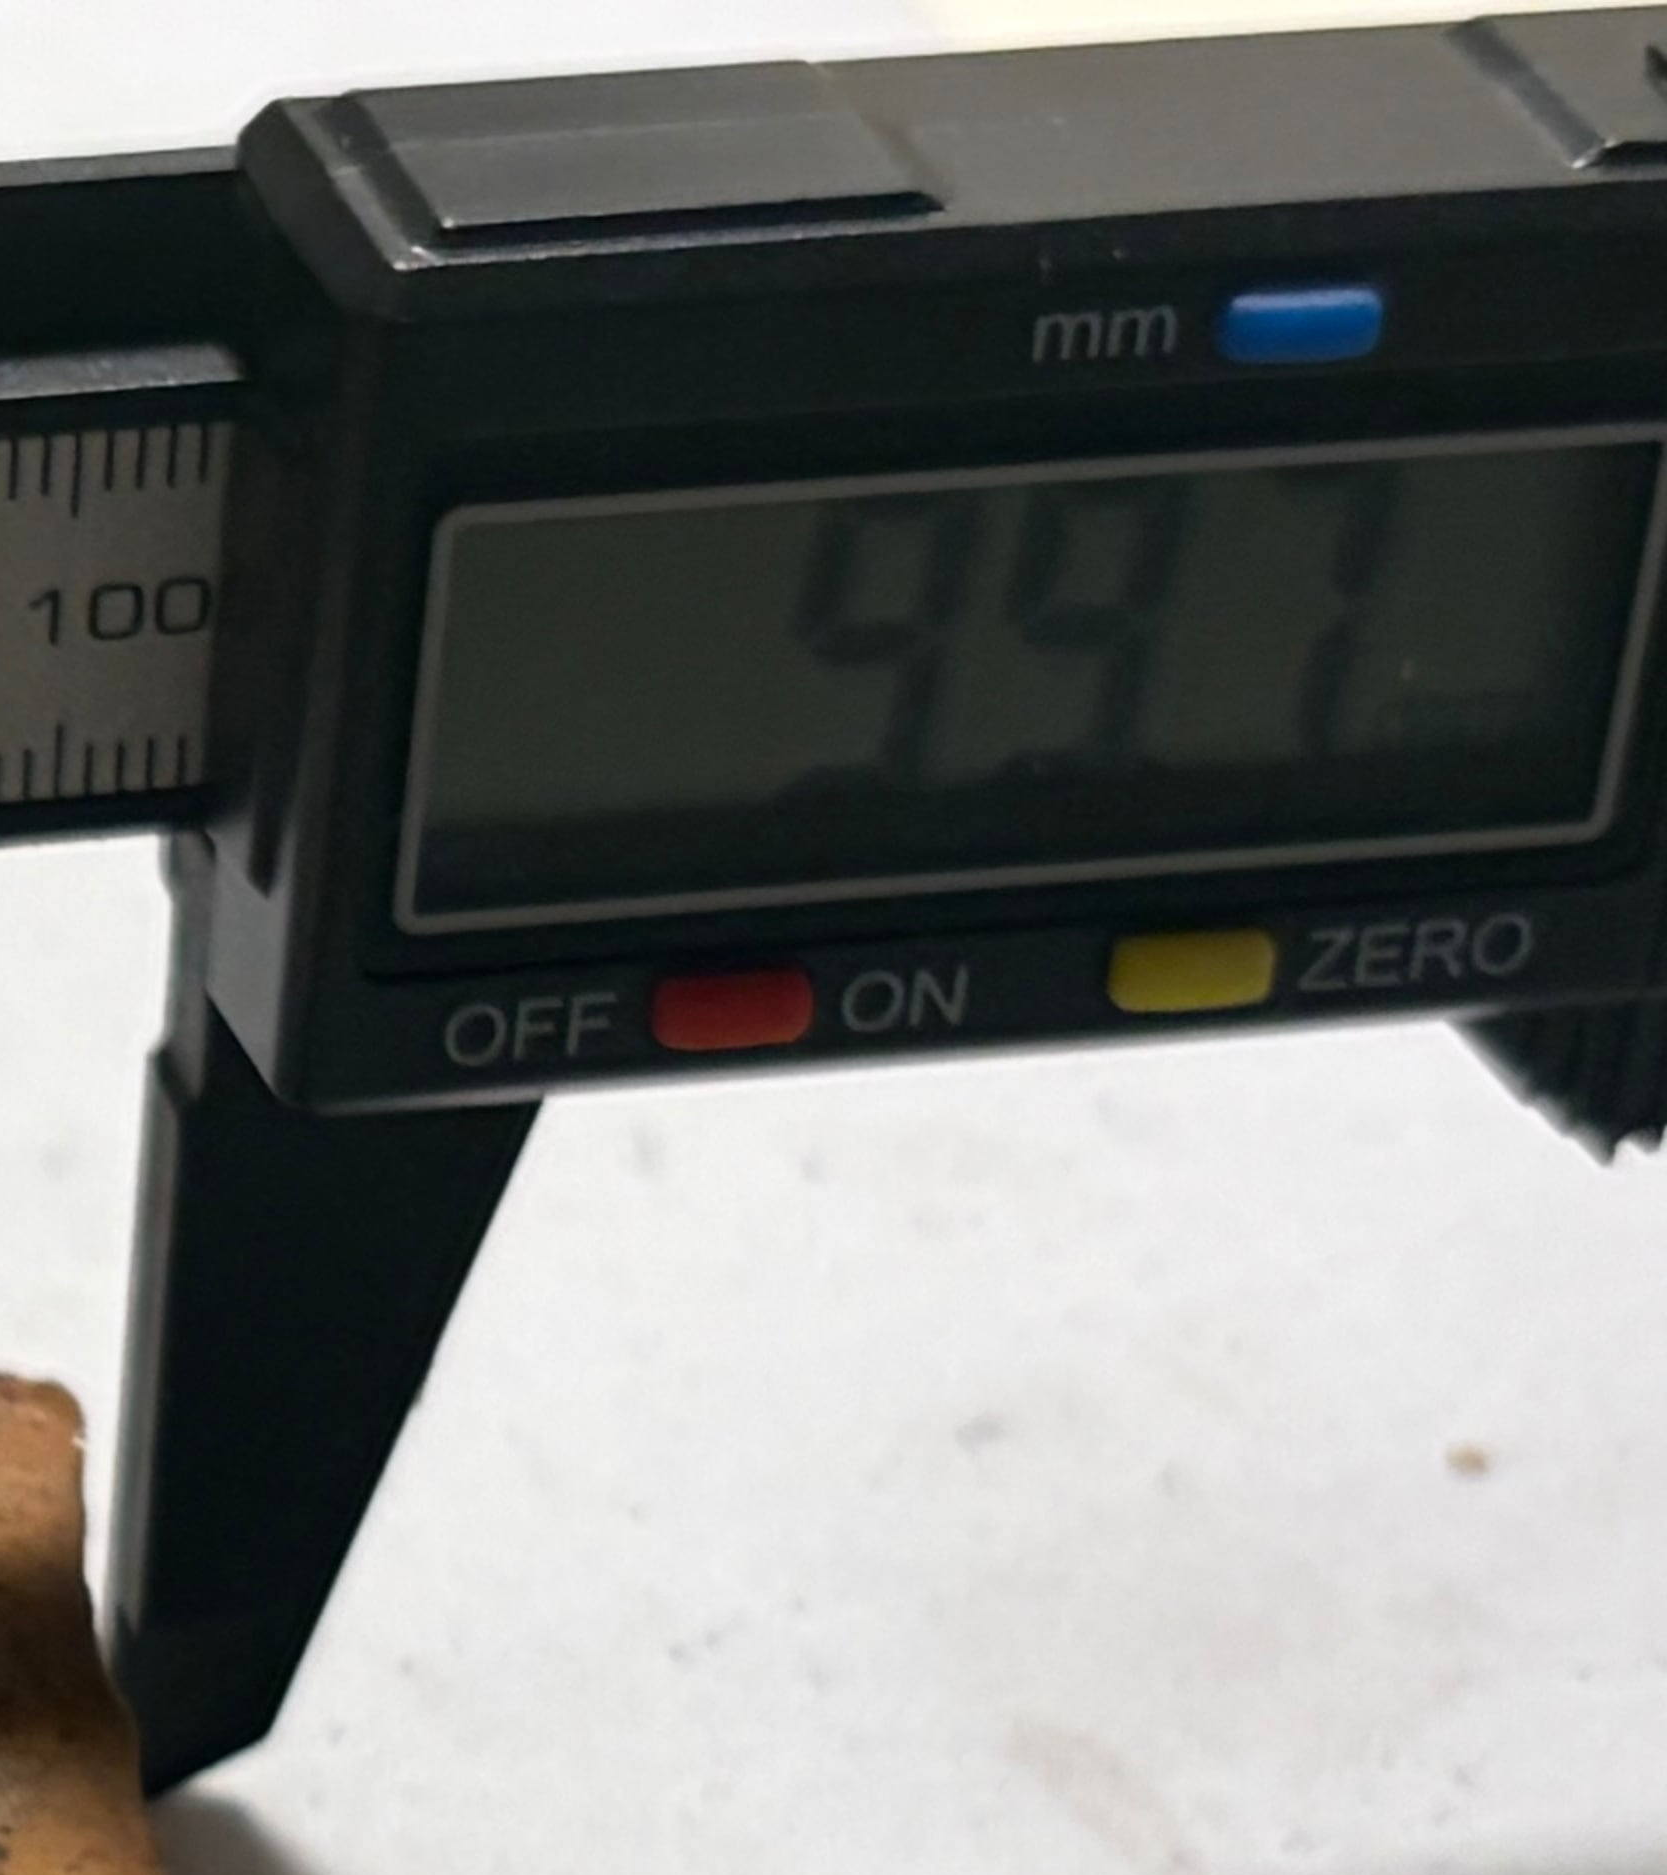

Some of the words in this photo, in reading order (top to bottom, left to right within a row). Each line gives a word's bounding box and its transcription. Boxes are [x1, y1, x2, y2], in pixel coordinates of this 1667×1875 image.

[1031, 302, 1177, 362] mm
[28, 577, 212, 645] 100
[1297, 915, 1535, 992] ZERO
[443, 996, 617, 1068] OFF
[841, 966, 969, 1034] ON
